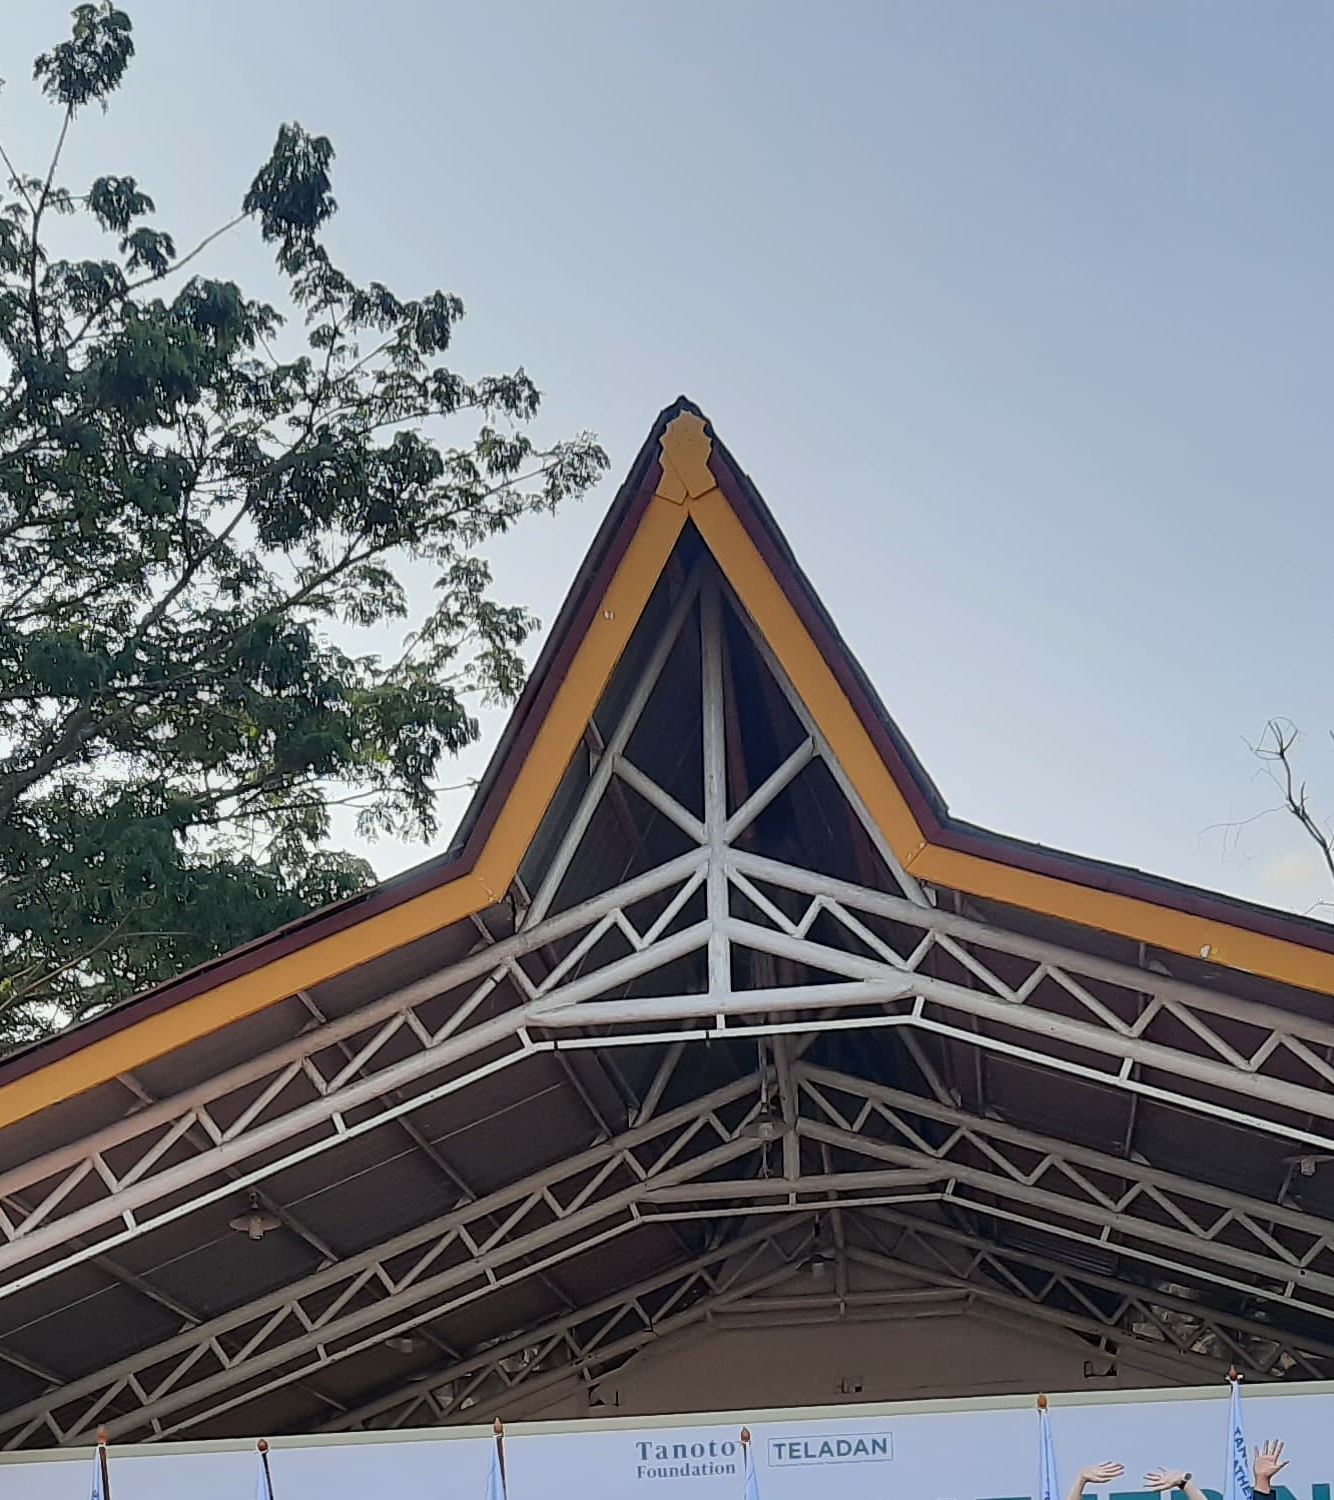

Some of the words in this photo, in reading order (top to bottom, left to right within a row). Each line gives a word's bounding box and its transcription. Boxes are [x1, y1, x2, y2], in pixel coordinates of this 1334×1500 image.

[635, 1439, 736, 1461] Tanoto
[773, 1438, 888, 1460] TELADAN
[637, 1461, 736, 1479] Foundation
